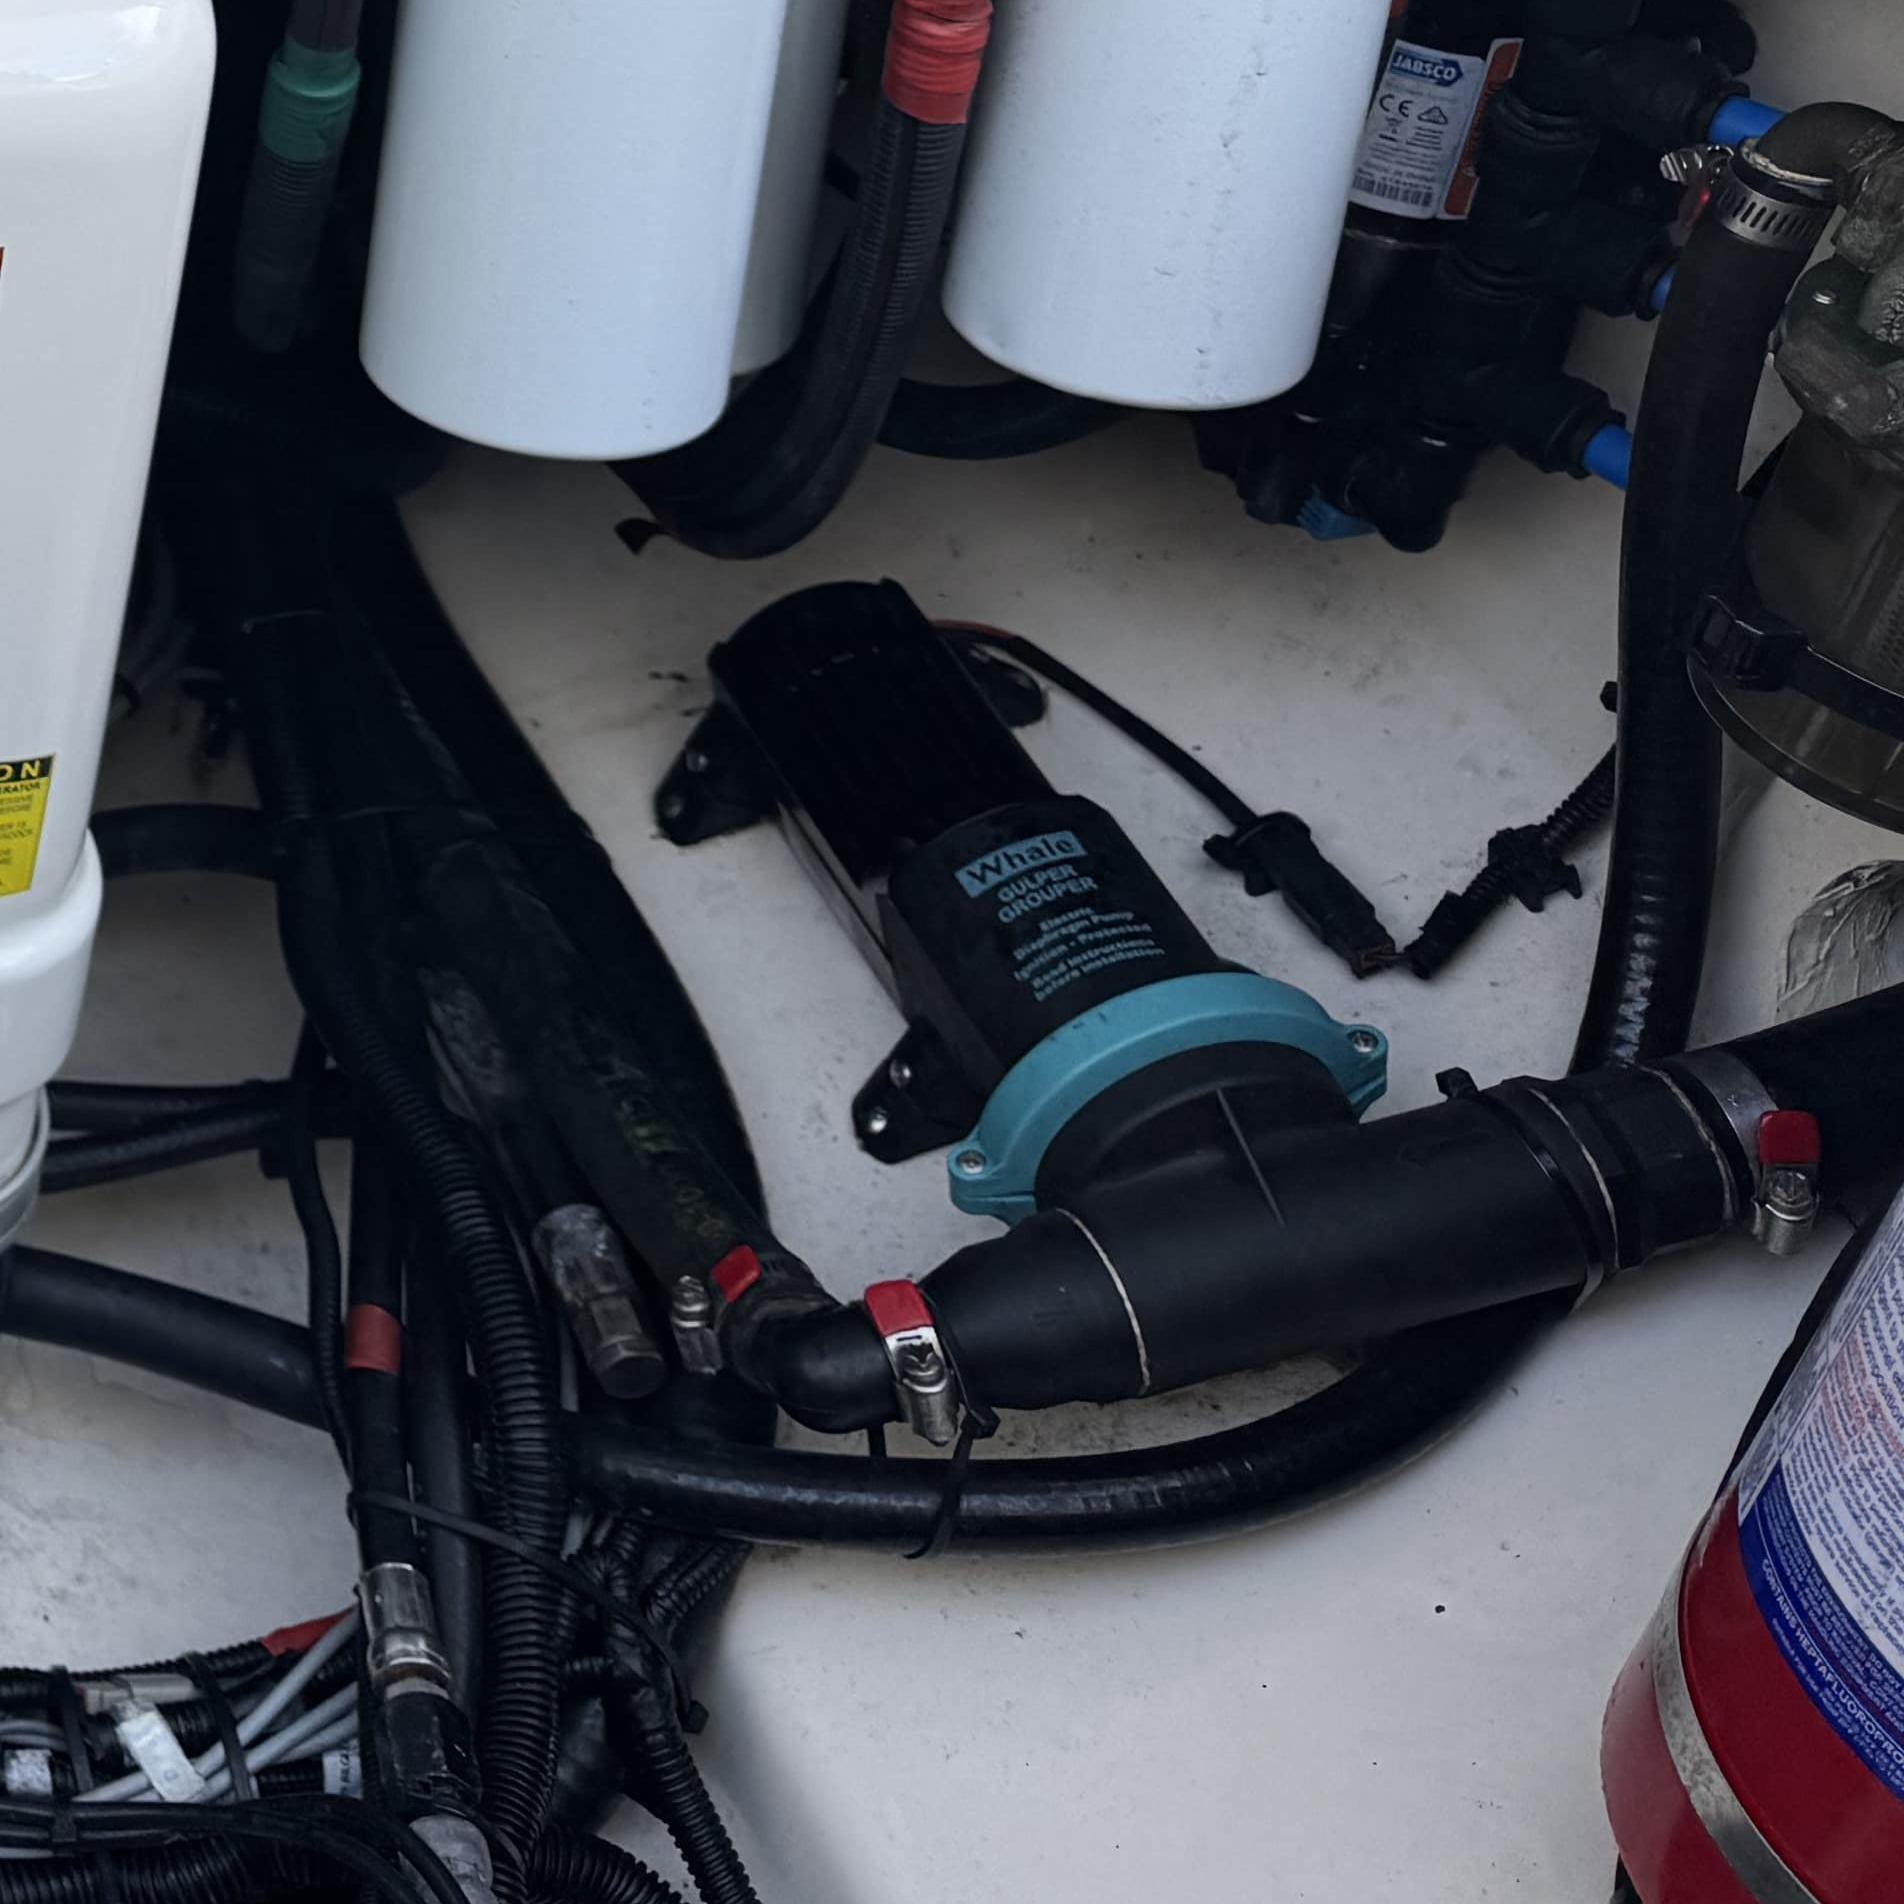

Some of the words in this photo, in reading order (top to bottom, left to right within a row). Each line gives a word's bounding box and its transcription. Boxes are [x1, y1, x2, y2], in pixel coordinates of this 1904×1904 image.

[1393, 55, 1456, 80] JABSCO
[967, 838, 1073, 885] Whale
[997, 864, 1078, 902] GULPER
[998, 876, 1098, 923] GROUPER
[1762, 1558, 1797, 1630] CONTAINS
[1795, 1626, 1904, 1768] HEPTAFLUOROPRO
